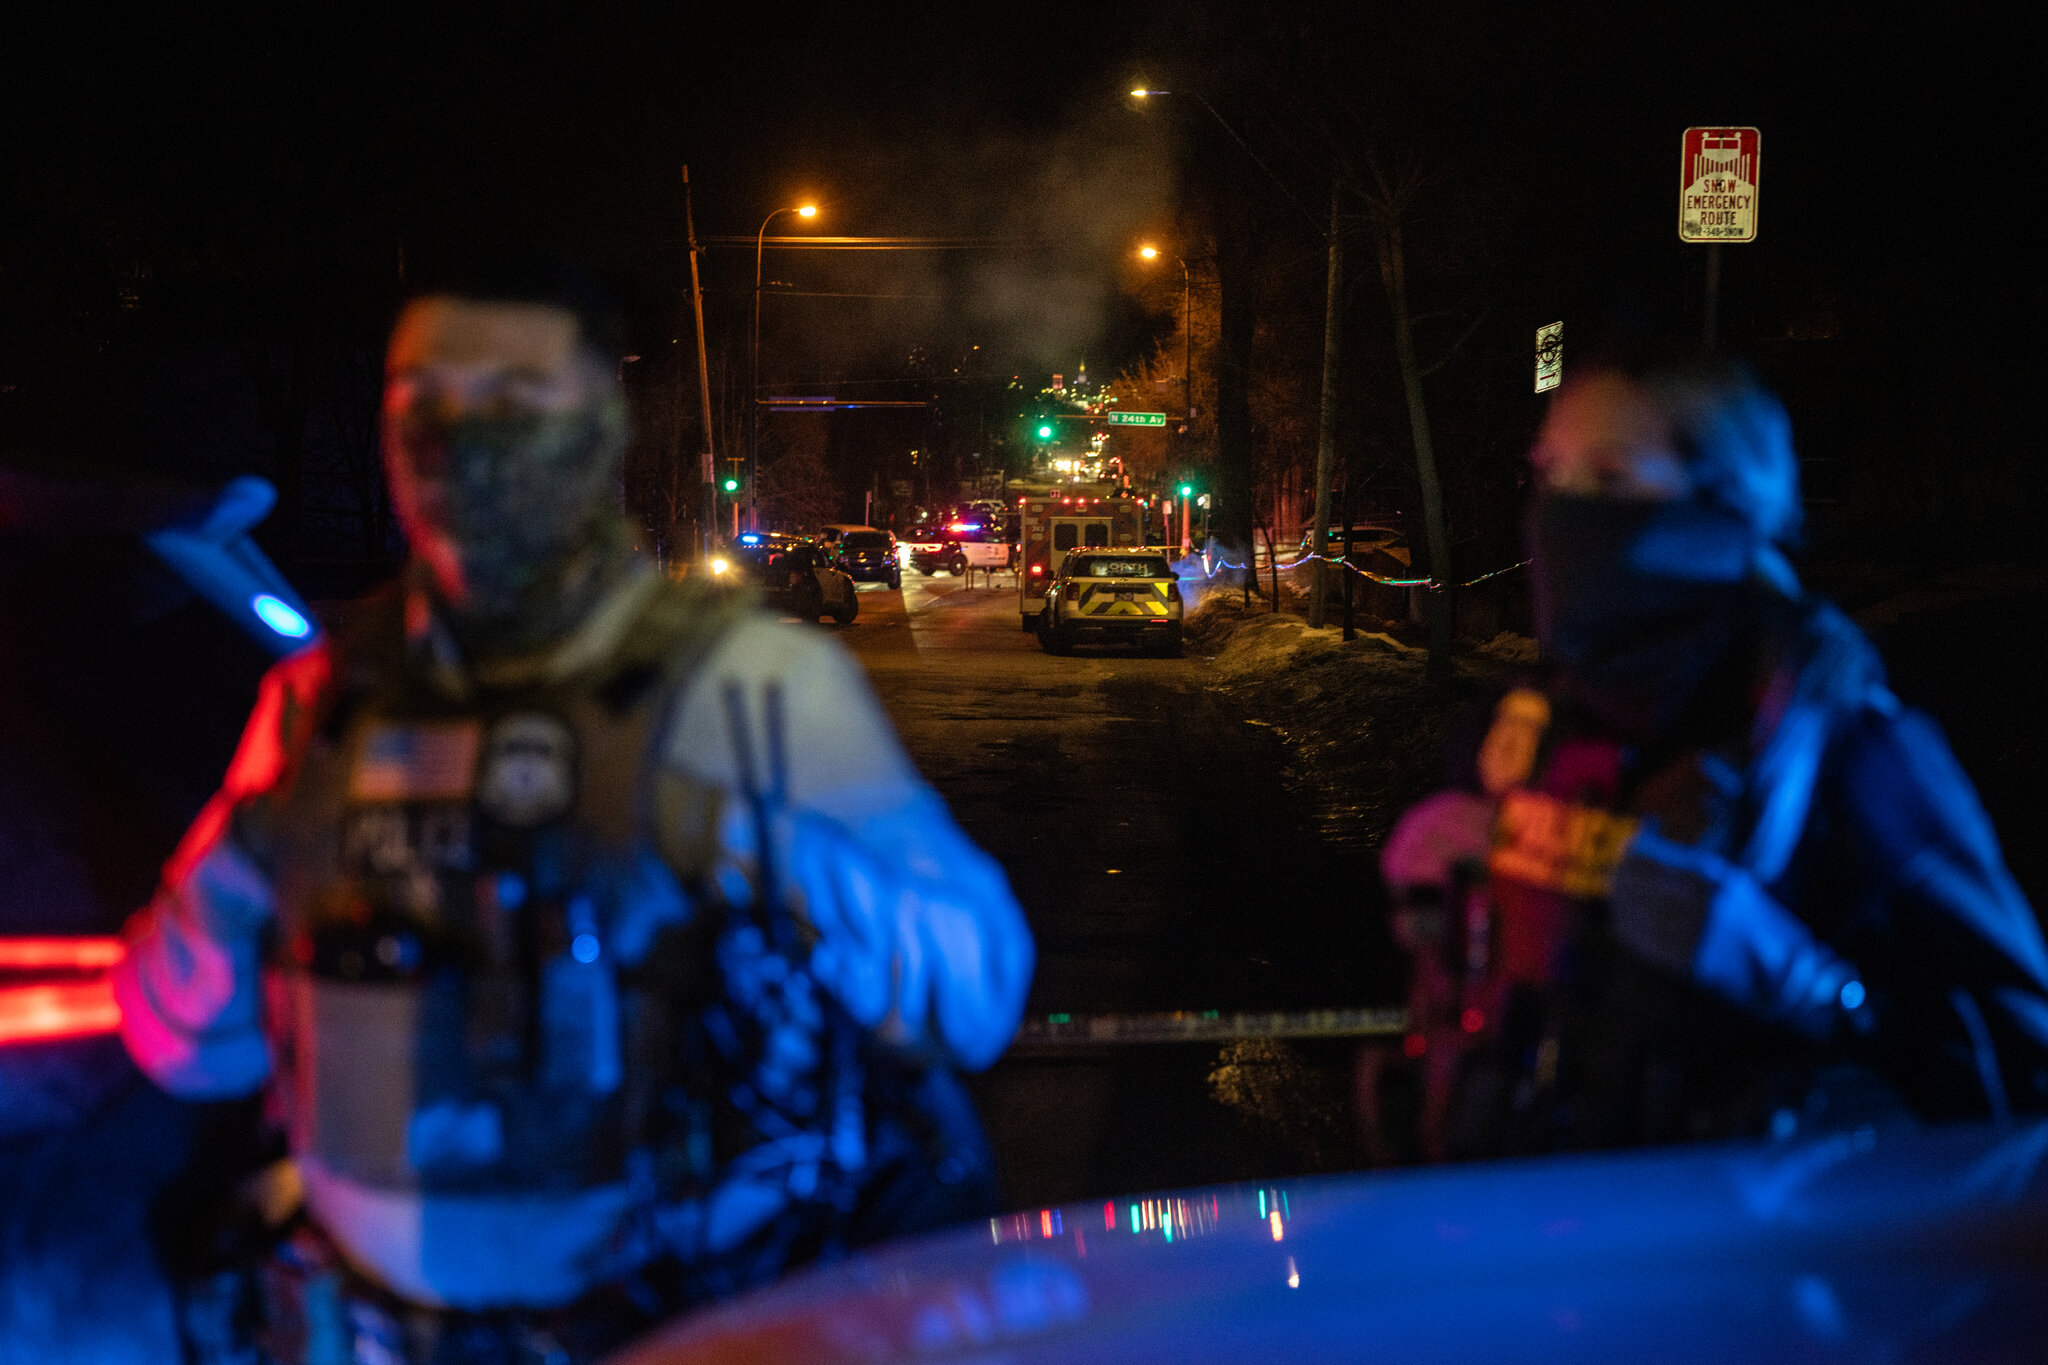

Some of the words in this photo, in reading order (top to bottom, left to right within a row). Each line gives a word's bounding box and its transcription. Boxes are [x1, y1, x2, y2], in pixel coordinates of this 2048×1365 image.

[1703, 179, 1736, 193] SNOW
[1687, 195, 1751, 209] EMERGENCY
[1700, 211, 1736, 225] ROUTE
[1111, 414, 1118, 422] N
[1122, 414, 1146, 423] 24th
[1149, 415, 1162, 424] Av
